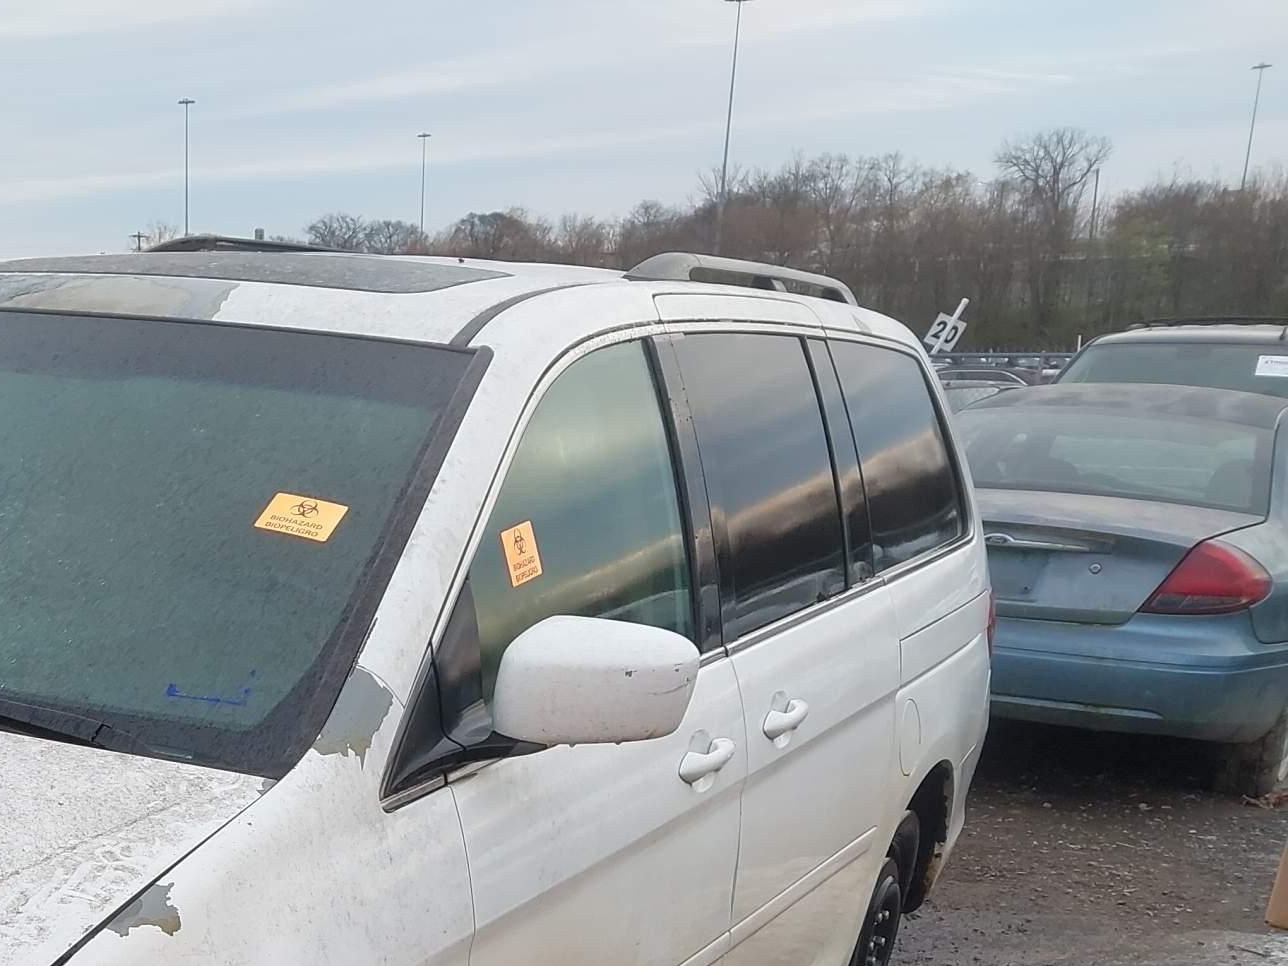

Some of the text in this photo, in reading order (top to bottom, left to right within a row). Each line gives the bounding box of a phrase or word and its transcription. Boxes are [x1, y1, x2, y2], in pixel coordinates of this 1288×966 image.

[930, 320, 959, 344] 20
[264, 521, 319, 538] BIOPELIGRO
[270, 514, 324, 531] BIOHAZARD
